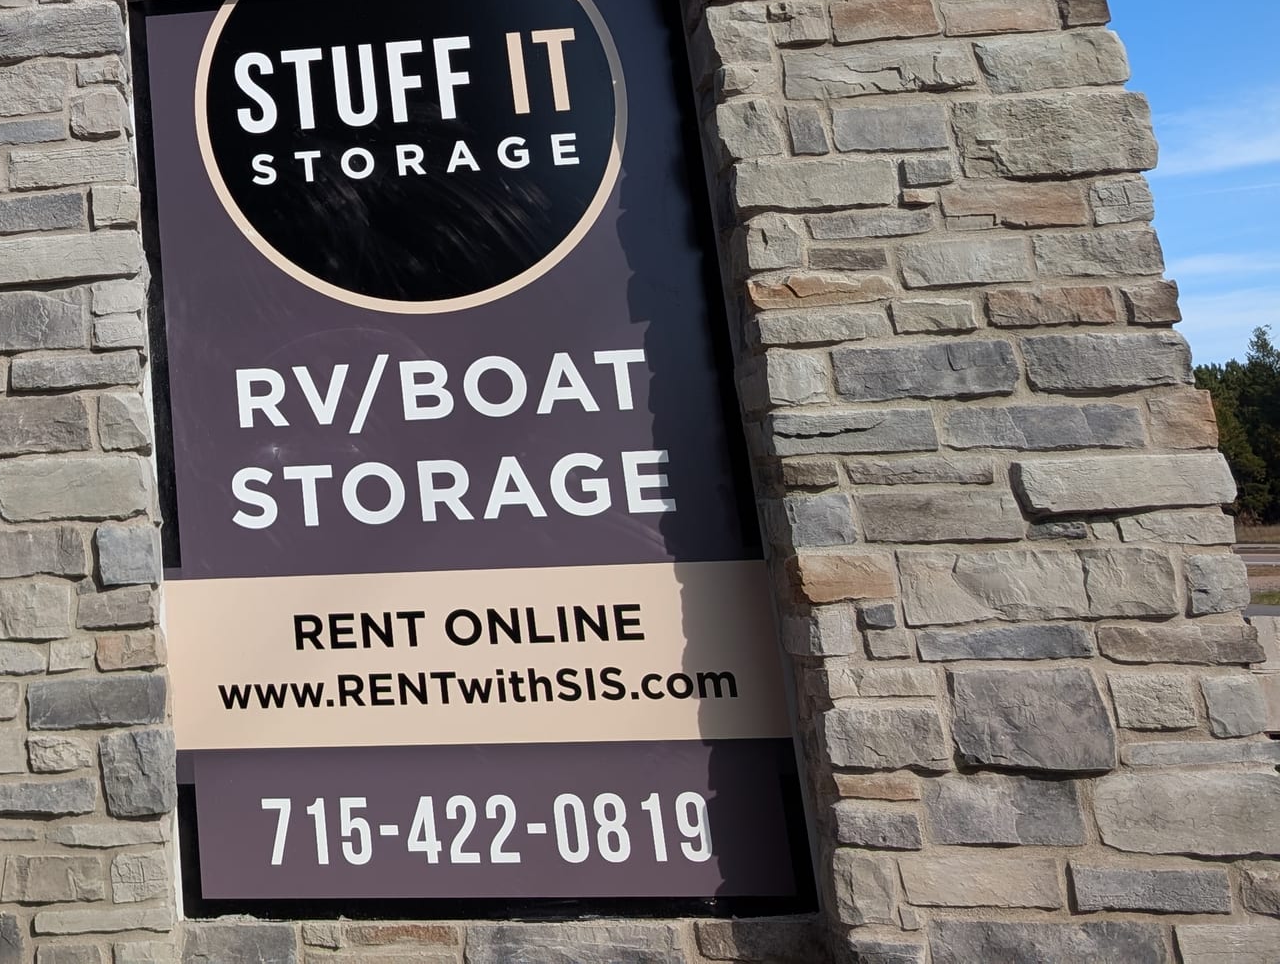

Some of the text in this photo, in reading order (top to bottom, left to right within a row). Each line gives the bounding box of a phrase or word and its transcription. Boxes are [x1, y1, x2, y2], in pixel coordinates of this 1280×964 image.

[234, 28, 576, 133] STUFF IT
[251, 132, 580, 185] STORAGE
[235, 348, 646, 434] RV/BOAT
[231, 449, 677, 529] STORAGE
[293, 603, 645, 650] RENT ONLINE
[218, 666, 738, 710] www.RENTwithSIS.com
[261, 791, 713, 865] 715-422-0819
